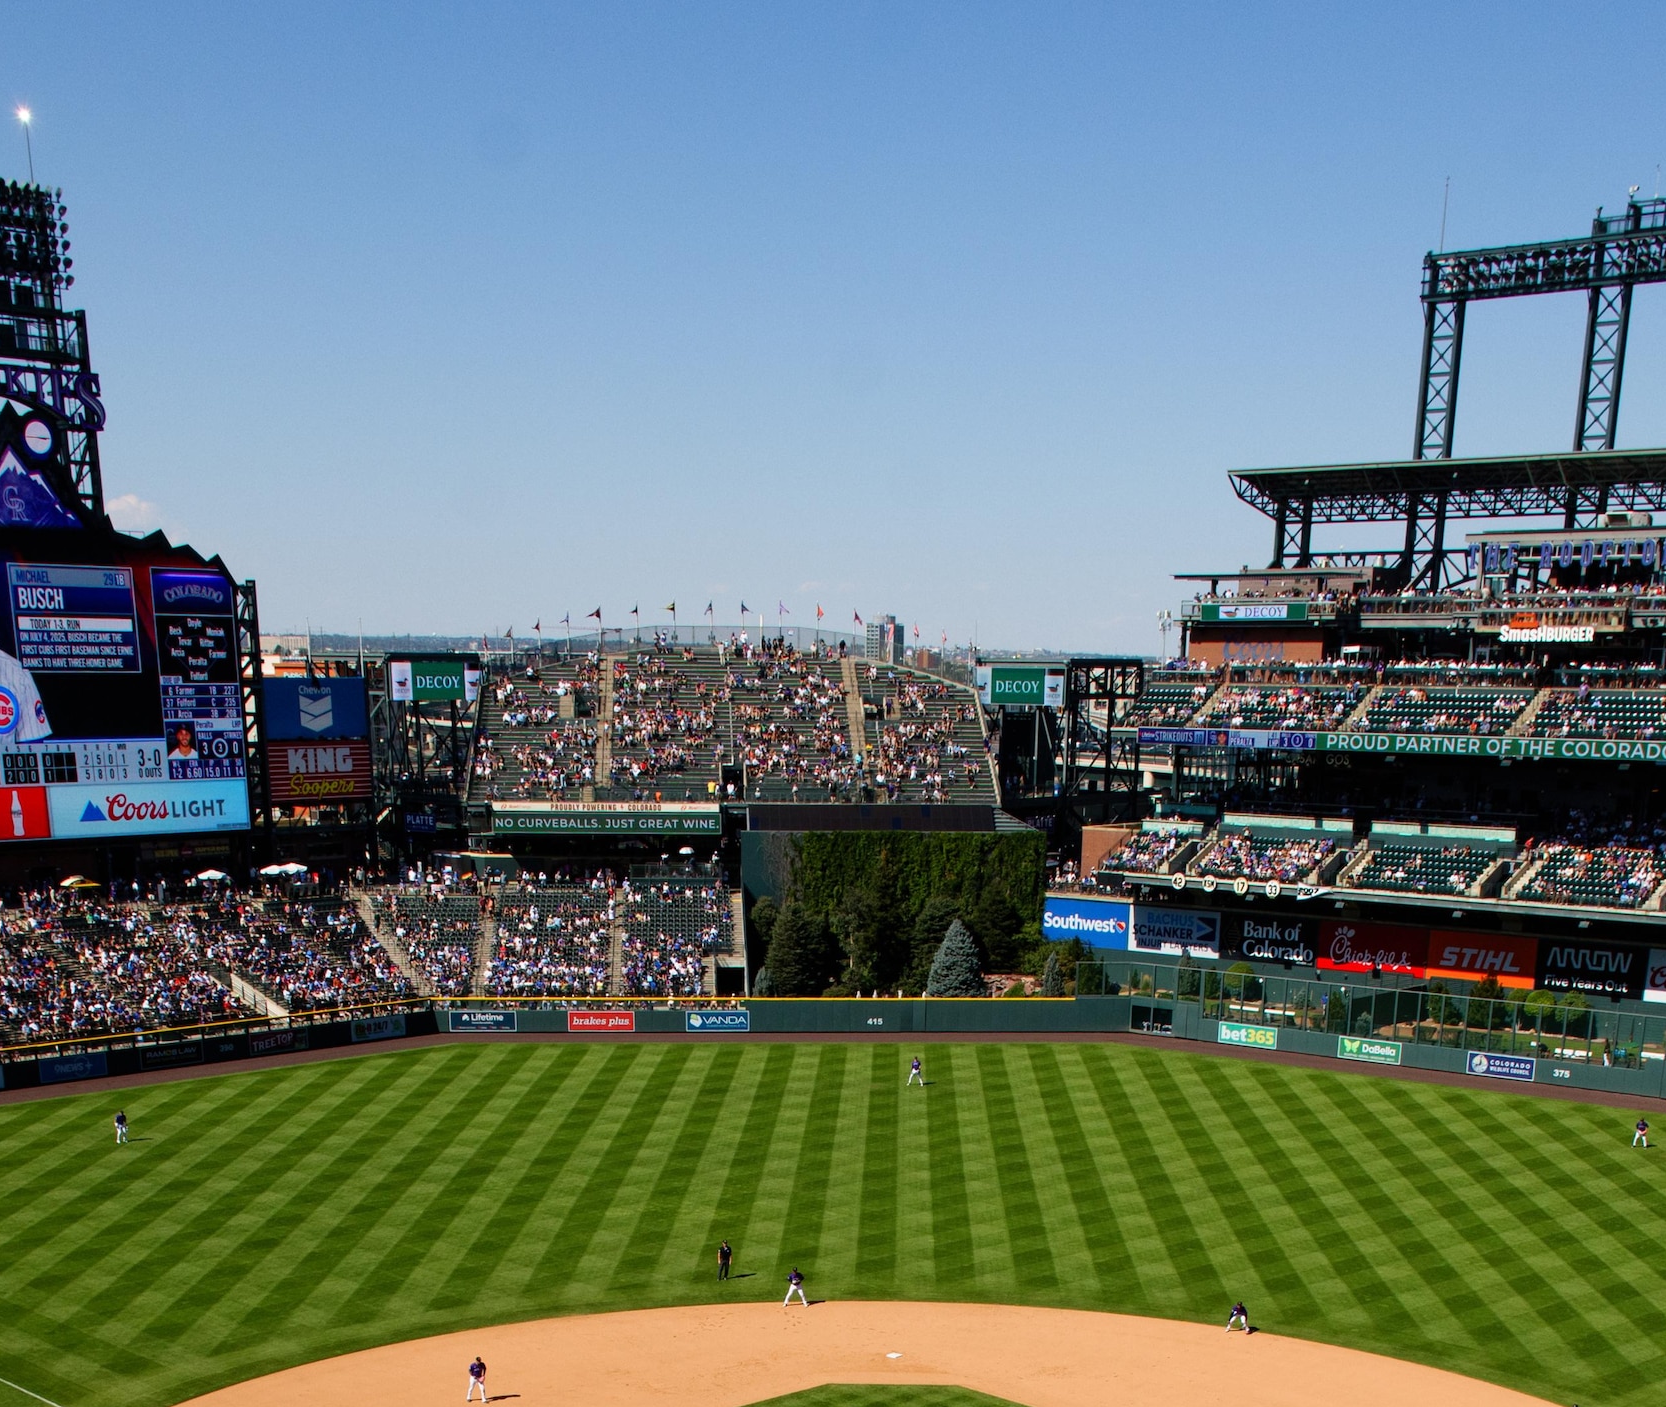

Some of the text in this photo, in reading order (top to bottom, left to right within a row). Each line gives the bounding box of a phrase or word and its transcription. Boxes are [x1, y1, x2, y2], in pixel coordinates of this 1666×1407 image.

[1468, 542, 1520, 571] THE
[16, 570, 124, 585] MICHAEL 29 1B
[17, 588, 64, 609] BUSCH
[164, 584, 223, 603] COLORADO
[30, 619, 80, 630] TODAY RUN
[20, 632, 29, 641] ON
[30, 633, 42, 641] JULY
[68, 633, 87, 642] BUSCH
[89, 634, 111, 642] BECAME
[113, 634, 123, 643] THE
[22, 645, 37, 654] FIRST
[39, 645, 54, 655] CUBS
[55, 646, 71, 655] FIRST
[73, 646, 99, 655] BASEMAN
[101, 646, 116, 655] SINCE
[23, 658, 43, 668] BANKS
[44, 658, 51, 668] TO
[53, 658, 68, 668] HAVE
[108, 659, 123, 668] GAME
[416, 676, 460, 689] DECOY
[996, 680, 1039, 693] DECOY
[1154, 732, 1193, 742] STRIKEOUTS
[1231, 738, 1253, 746] PERALTA
[1327, 735, 1389, 750] PROUD
[1396, 738, 1480, 753] PARTNER
[1486, 739, 1512, 754] OF
[1518, 741, 1555, 755] THE
[287, 748, 352, 774] KING
[289, 774, 354, 799] Soopers
[106, 796, 225, 821] Coors LIGHT
[550, 803, 580, 811] PROUDLY
[583, 803, 616, 811] POWERING
[495, 819, 719, 829] NO CURVEBALLS. JUST GREAT WINE.
[1044, 912, 1115, 933] Southwest
[1147, 913, 1194, 926] BACHUS
[1133, 923, 1193, 940] SCHANKER
[1243, 920, 1301, 941] Bank of
[1137, 938, 1167, 949] INJURY
[1242, 940, 1313, 963] Colorado
[1440, 947, 1520, 972] STIHL
[1545, 974, 1628, 992] Five Years Out
[573, 1017, 629, 1026] brakes plus
[703, 1016, 746, 1024] VANDA
[1221, 1025, 1275, 1045] bet365
[177, 1047, 197, 1055] LAW
[1362, 1044, 1396, 1056] DaBella
[1490, 1060, 1531, 1070] COLORADO
[1553, 1069, 1570, 1078] 375
